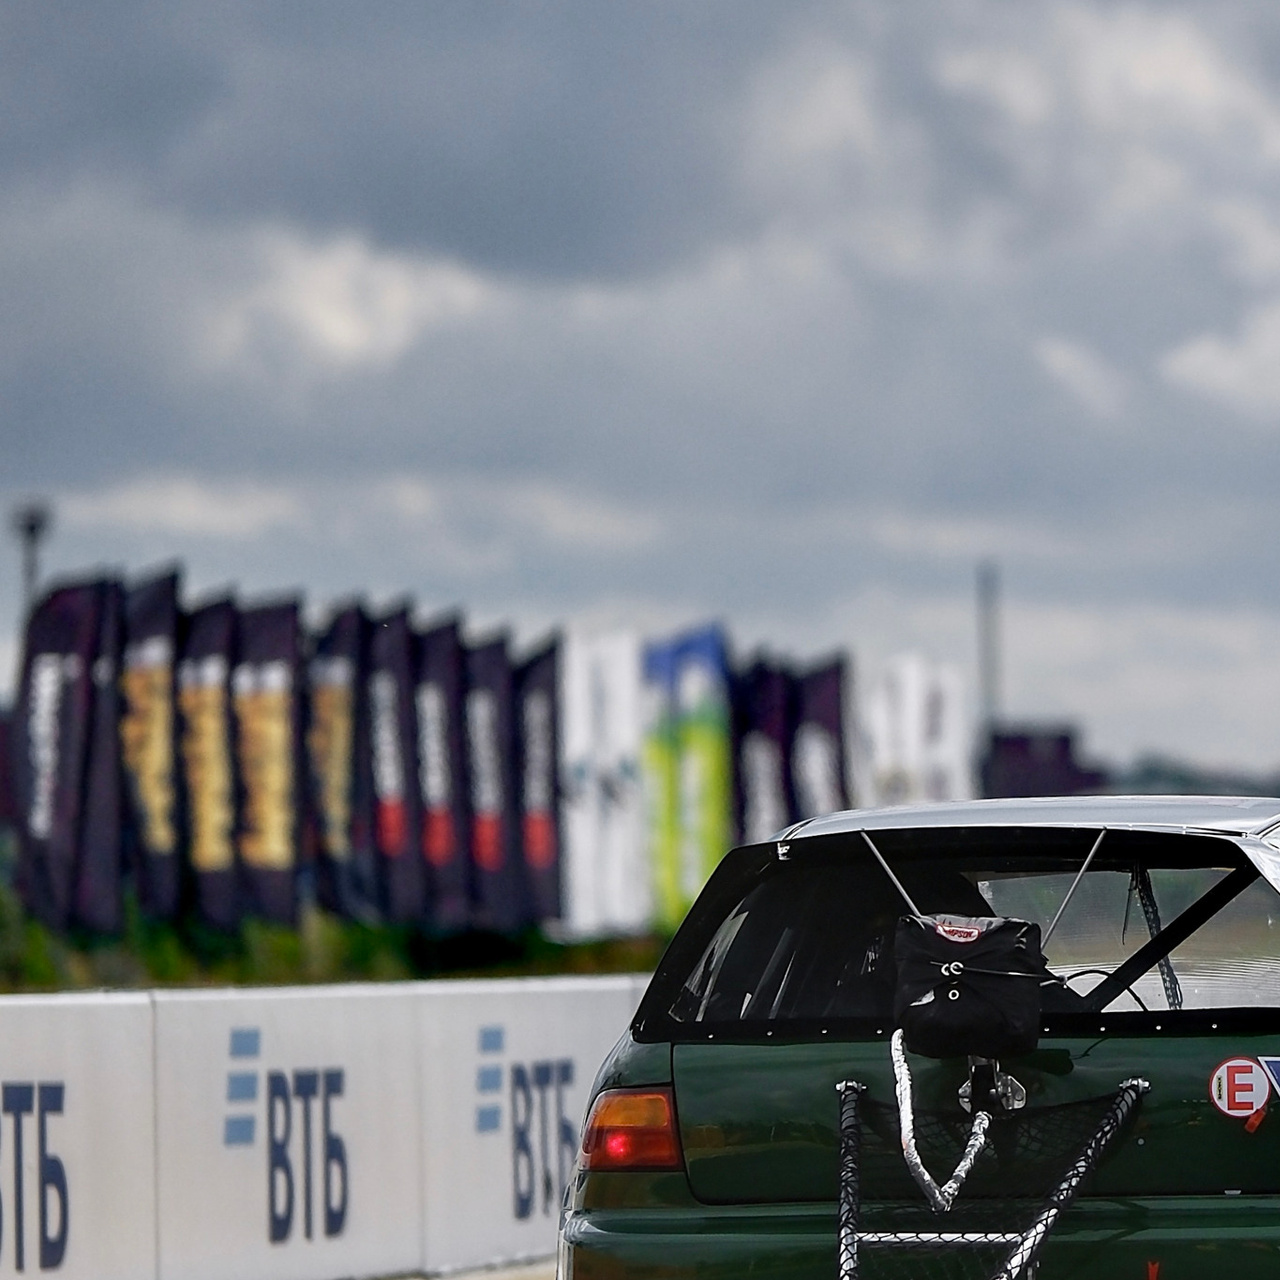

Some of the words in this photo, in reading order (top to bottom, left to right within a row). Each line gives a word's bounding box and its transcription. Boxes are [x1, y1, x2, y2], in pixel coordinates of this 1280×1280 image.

[0, 1081, 69, 1272] ТБ
[267, 1068, 348, 1245] ВТБ
[1227, 1066, 1254, 1110] E
